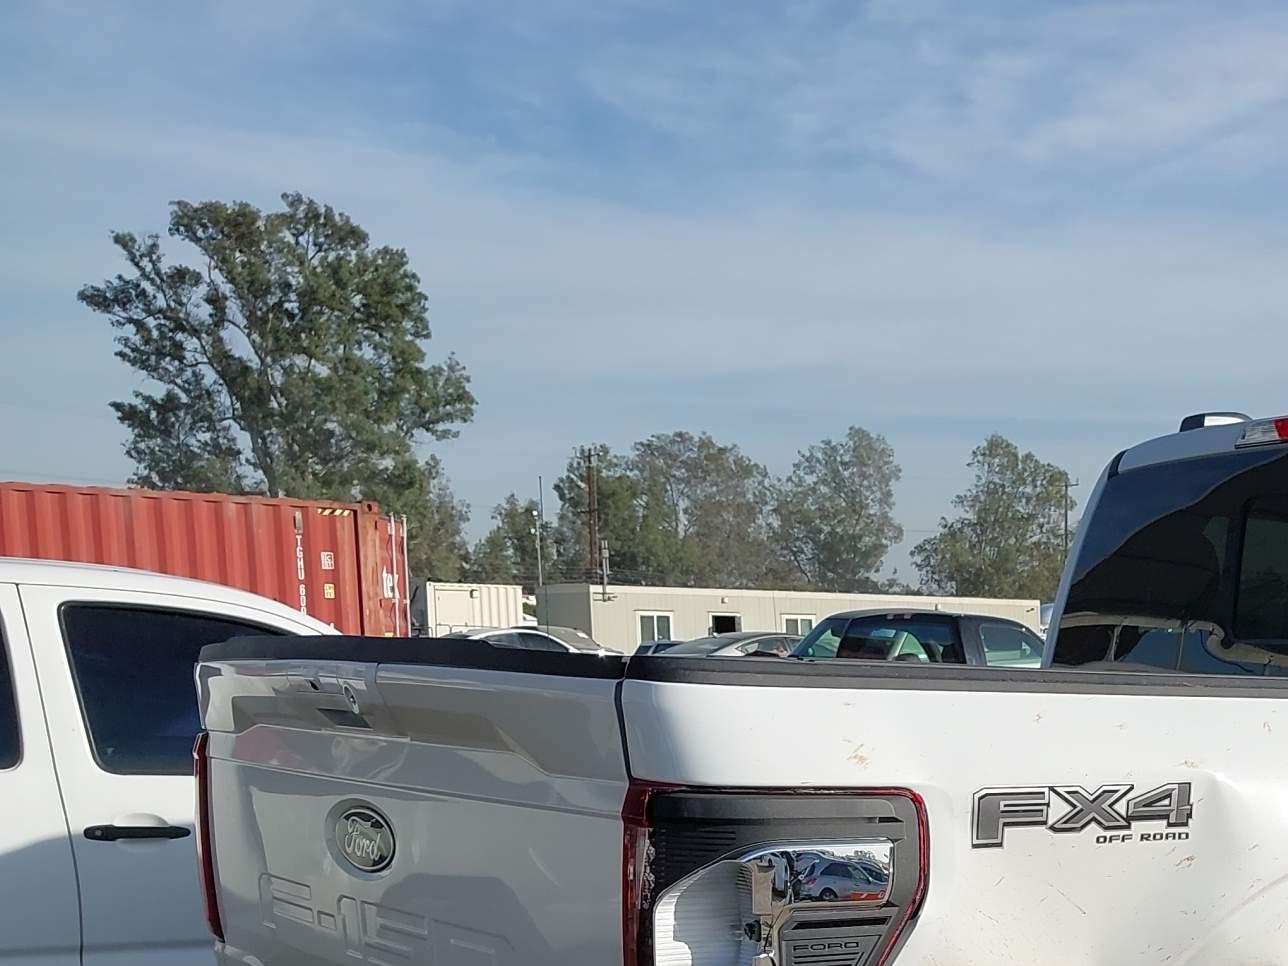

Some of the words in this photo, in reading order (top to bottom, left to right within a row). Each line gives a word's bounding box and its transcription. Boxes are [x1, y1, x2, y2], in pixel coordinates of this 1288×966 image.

[971, 782, 1193, 848] FX4
[345, 816, 382, 860] Ford
[1095, 834, 1134, 844] OFF
[1139, 832, 1189, 841] ROAD
[793, 941, 859, 953] FORD
